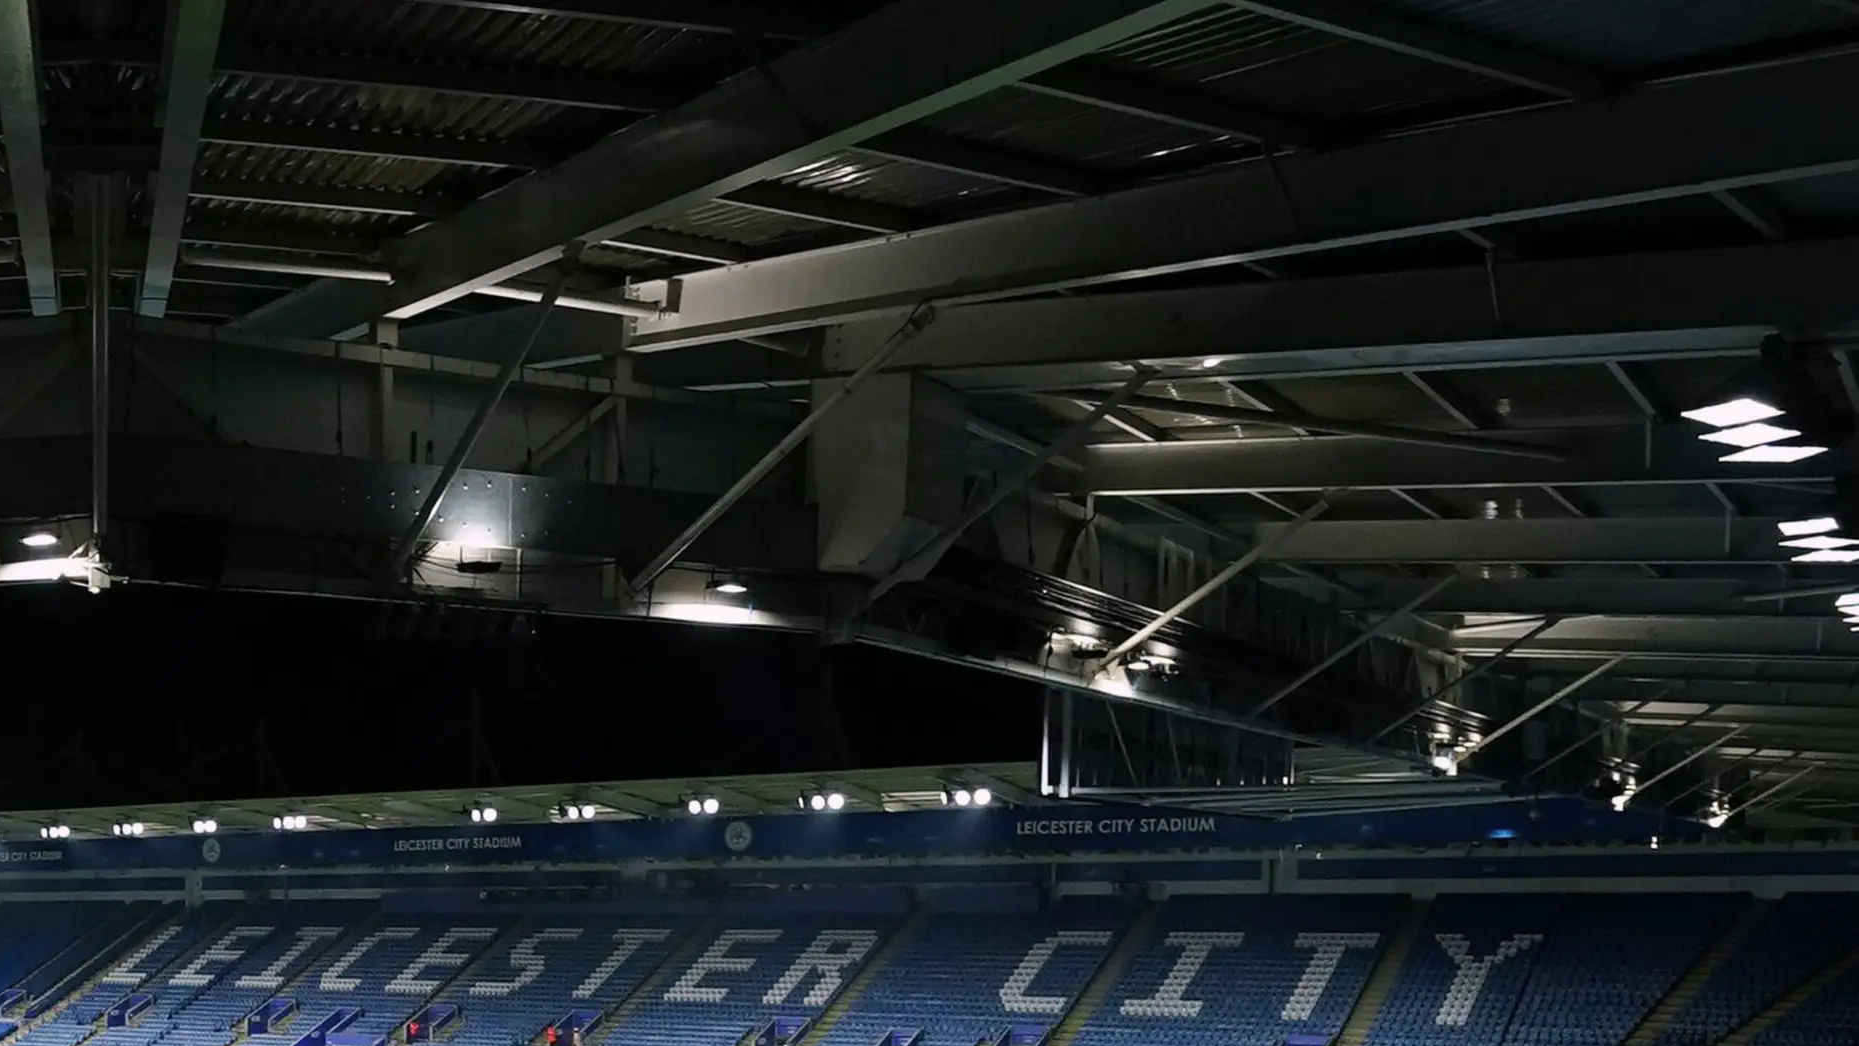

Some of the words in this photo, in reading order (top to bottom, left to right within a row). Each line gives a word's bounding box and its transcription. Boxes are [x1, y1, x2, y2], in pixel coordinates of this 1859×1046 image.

[1016, 819, 1094, 835] LEICESTER
[1098, 818, 1135, 834] CITY
[1140, 816, 1216, 833] STADIUM
[394, 839, 443, 851] LEICESTER
[446, 838, 470, 850] CITY
[472, 835, 522, 849] STADIUM
[101, 925, 879, 1007] LEICESTER
[998, 930, 1544, 1026] CITY
